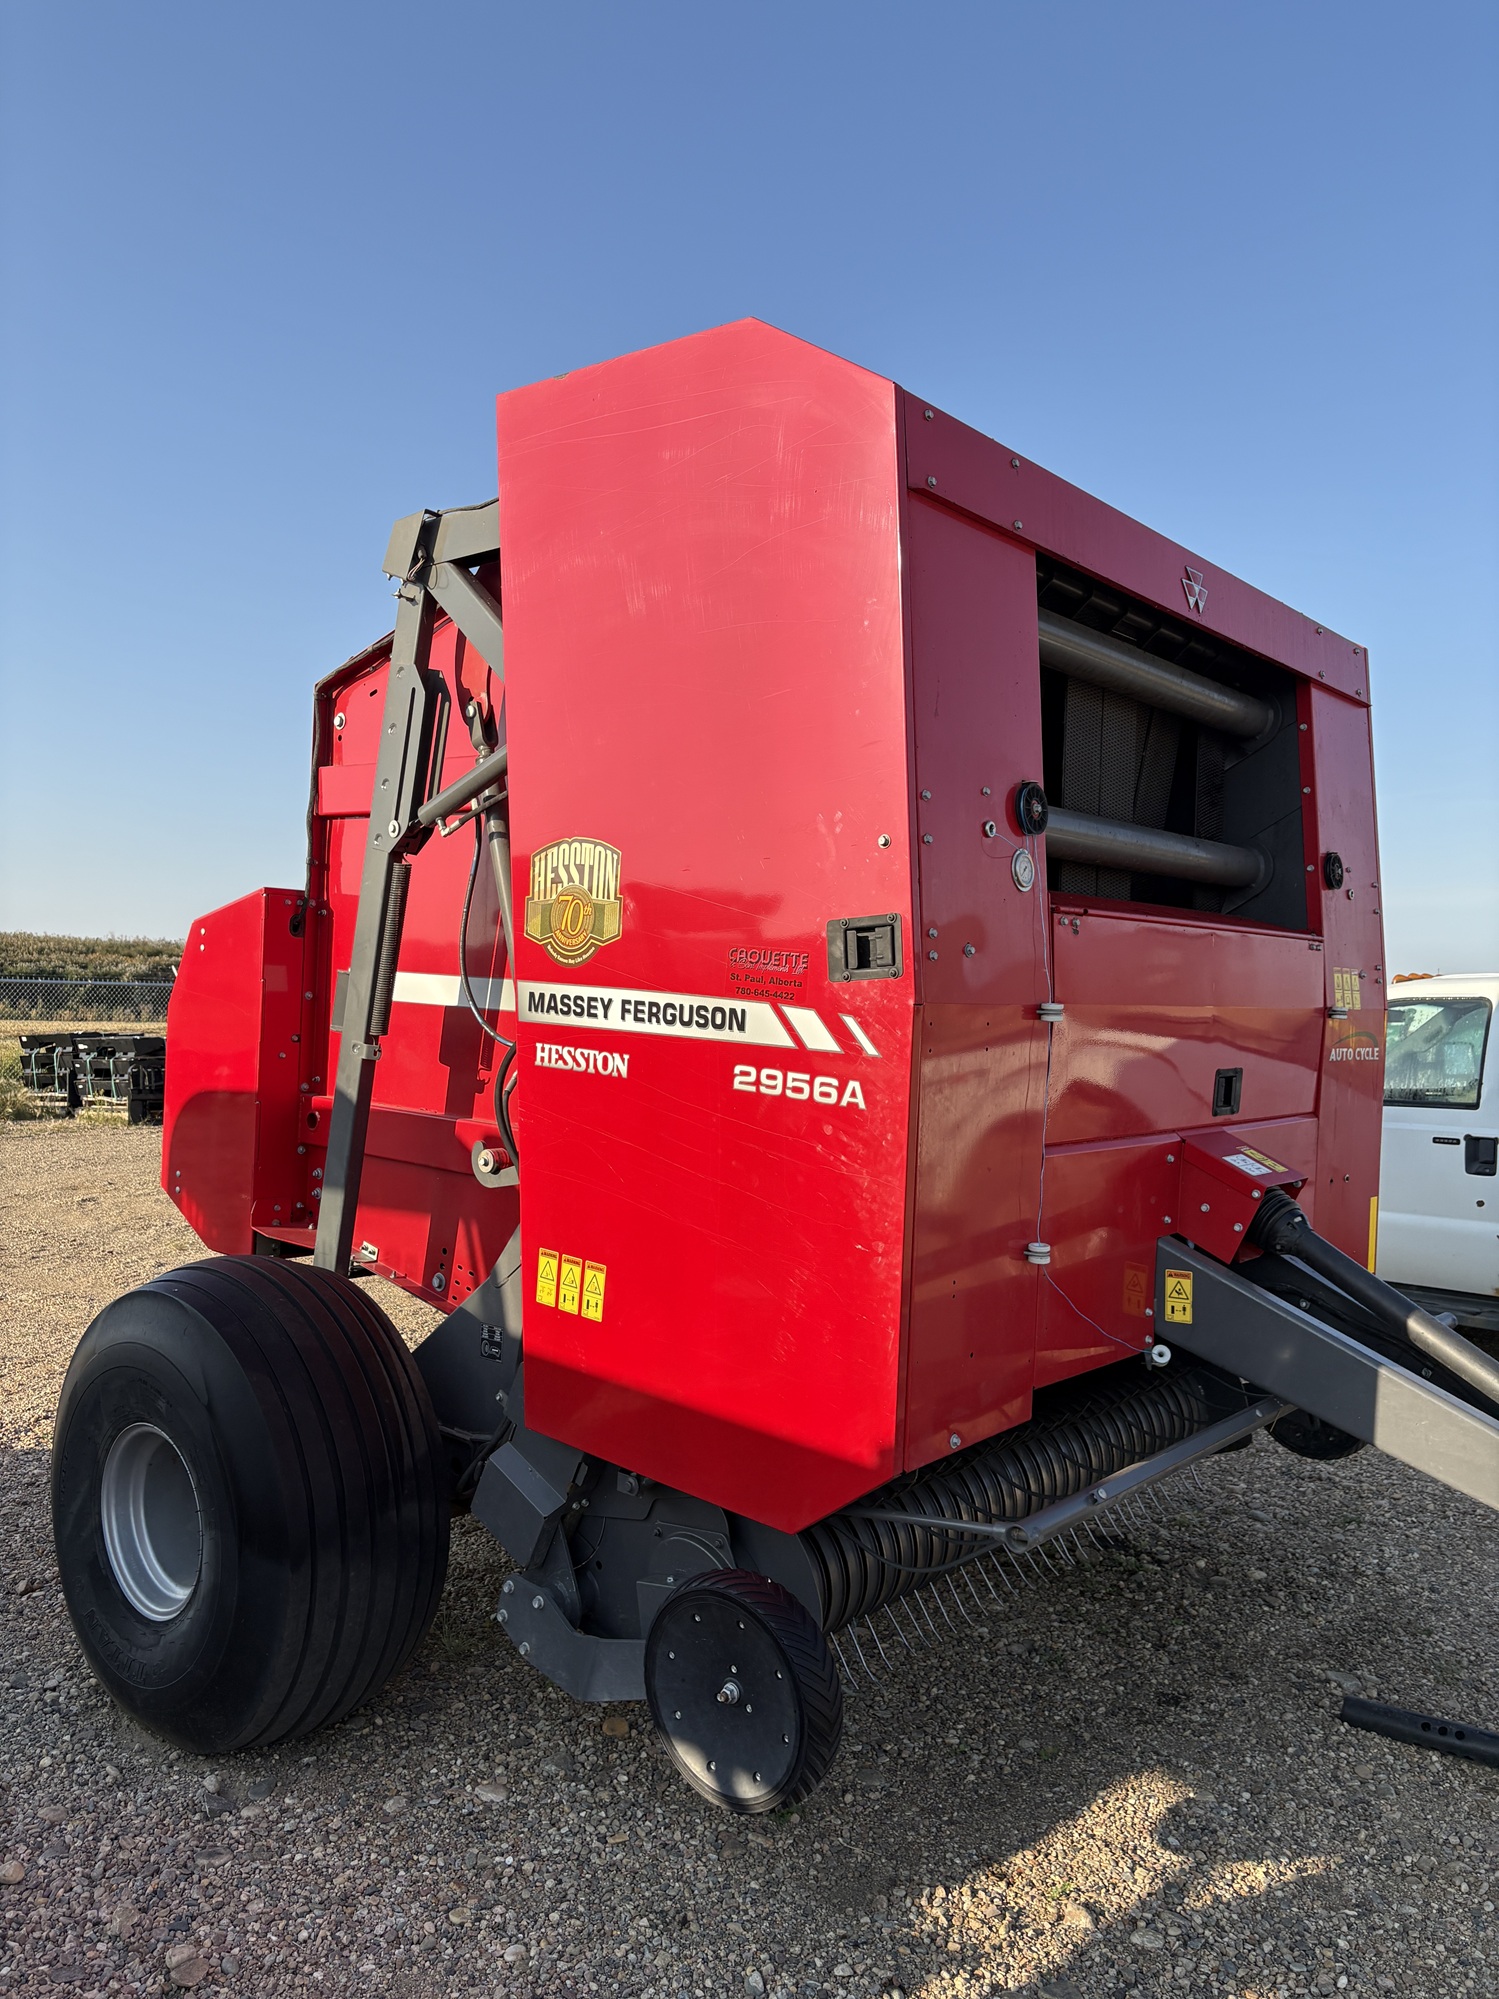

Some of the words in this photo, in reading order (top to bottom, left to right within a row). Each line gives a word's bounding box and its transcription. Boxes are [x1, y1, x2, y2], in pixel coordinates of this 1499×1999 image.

[535, 843, 617, 901] HESSTON
[558, 894, 592, 935] 70th
[555, 929, 588, 946] ANNIVERSARY
[730, 973, 742, 982] St.
[744, 974, 766, 985] Paul,
[768, 976, 803, 988] Alberta
[735, 986, 795, 1001] 780-645-4422
[527, 991, 613, 1020] MASSEY
[620, 998, 746, 1033] FERGUSON
[534, 1042, 630, 1079] HESSTON
[1329, 1048, 1353, 1062] AUTO
[1355, 1047, 1379, 1061] CYCLE
[732, 1064, 866, 1110] 2956A
[83, 1608, 147, 1686] TITAN
